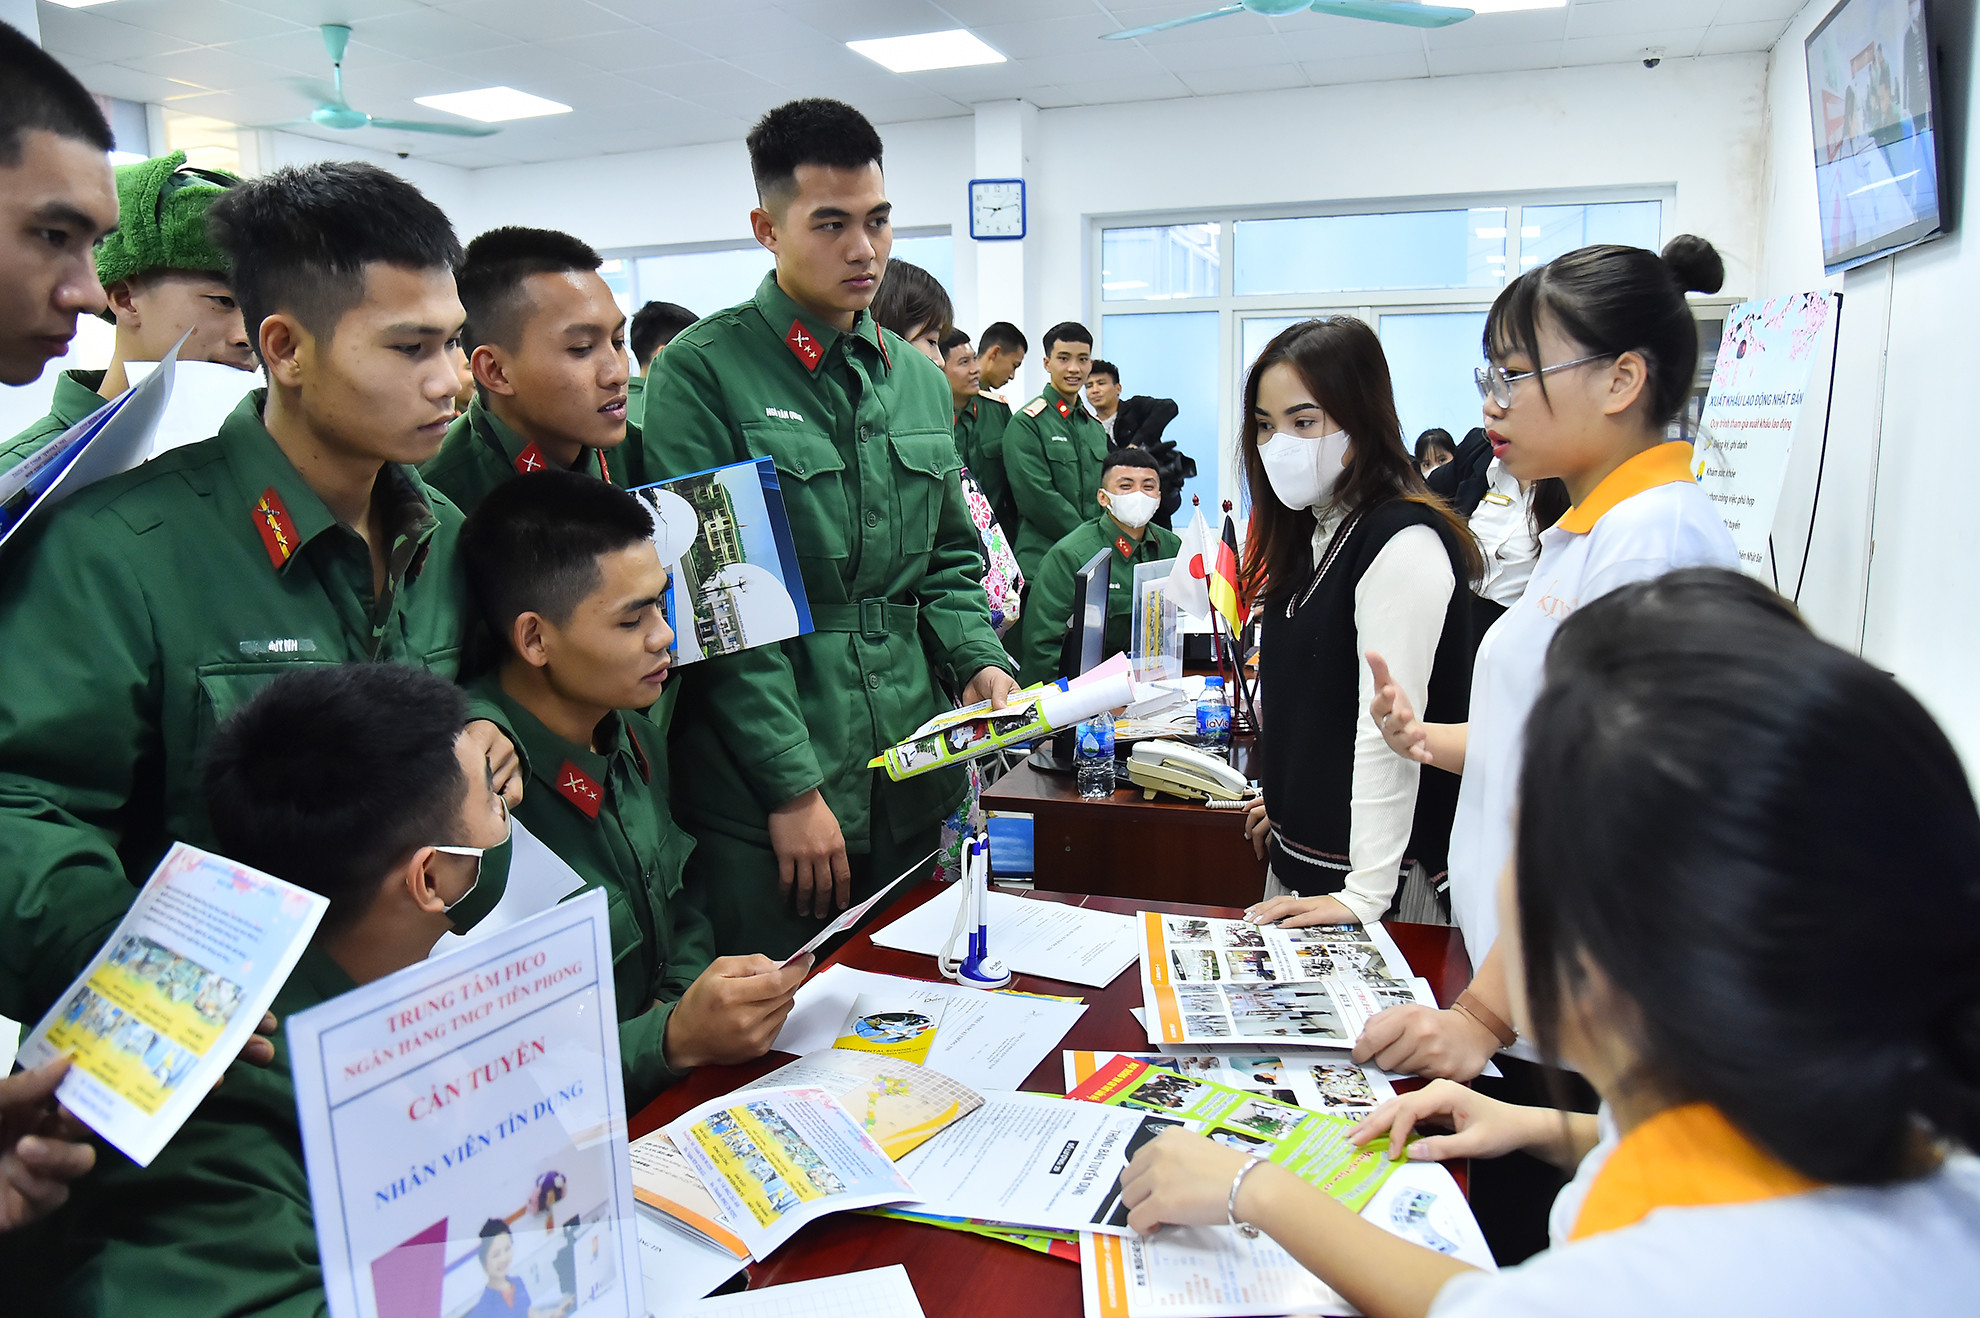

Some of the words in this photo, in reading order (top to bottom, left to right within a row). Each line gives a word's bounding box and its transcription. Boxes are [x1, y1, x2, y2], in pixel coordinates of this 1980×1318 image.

[1772, 390, 1791, 408] NHẬT
[343, 1048, 395, 1081] NGÂN
[398, 1024, 448, 1057] HÀNG
[449, 1001, 495, 1032] TMCP
[534, 960, 584, 993] PHONG
[386, 990, 456, 1034] TRUNG
[460, 969, 501, 1002] TÂM
[504, 951, 547, 983] FICO
[375, 1159, 438, 1211] NHÂN
[442, 1128, 492, 1169] VIÊN
[496, 1108, 530, 1140] TÍN
[533, 1079, 584, 1121] DỤNG
